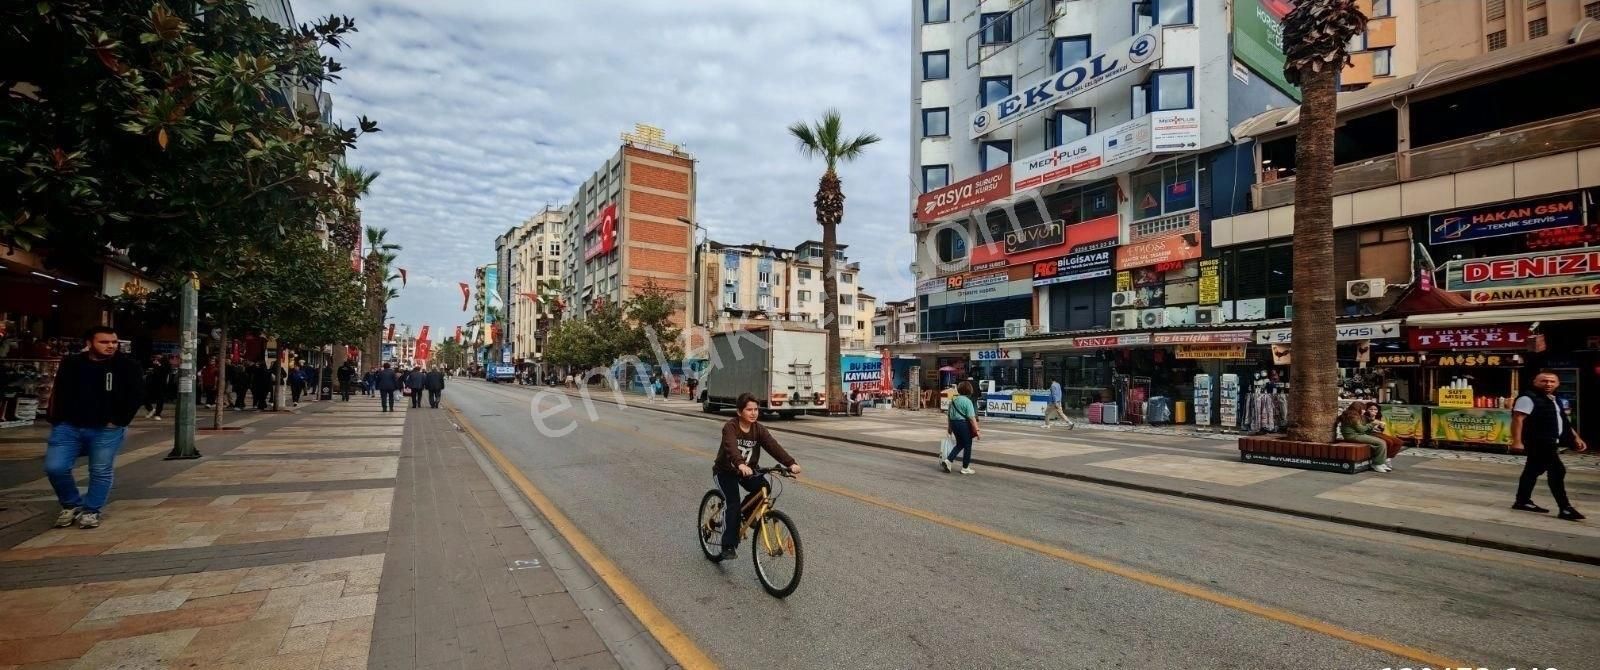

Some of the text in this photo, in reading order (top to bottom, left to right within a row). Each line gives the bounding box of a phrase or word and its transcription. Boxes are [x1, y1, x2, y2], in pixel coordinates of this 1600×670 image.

[998, 53, 1118, 120] EKOL
[937, 184, 972, 207] asya
[1472, 201, 1574, 224] HAKAN GSM
[1522, 215, 1556, 226] SERVİS
[1057, 252, 1109, 267] BİLGİSAYAR
[1491, 285, 1588, 300] ANAHTARCI
[1418, 332, 1525, 346] TEKEL
[978, 348, 1010, 359] saatix
[850, 362, 861, 370] BU
